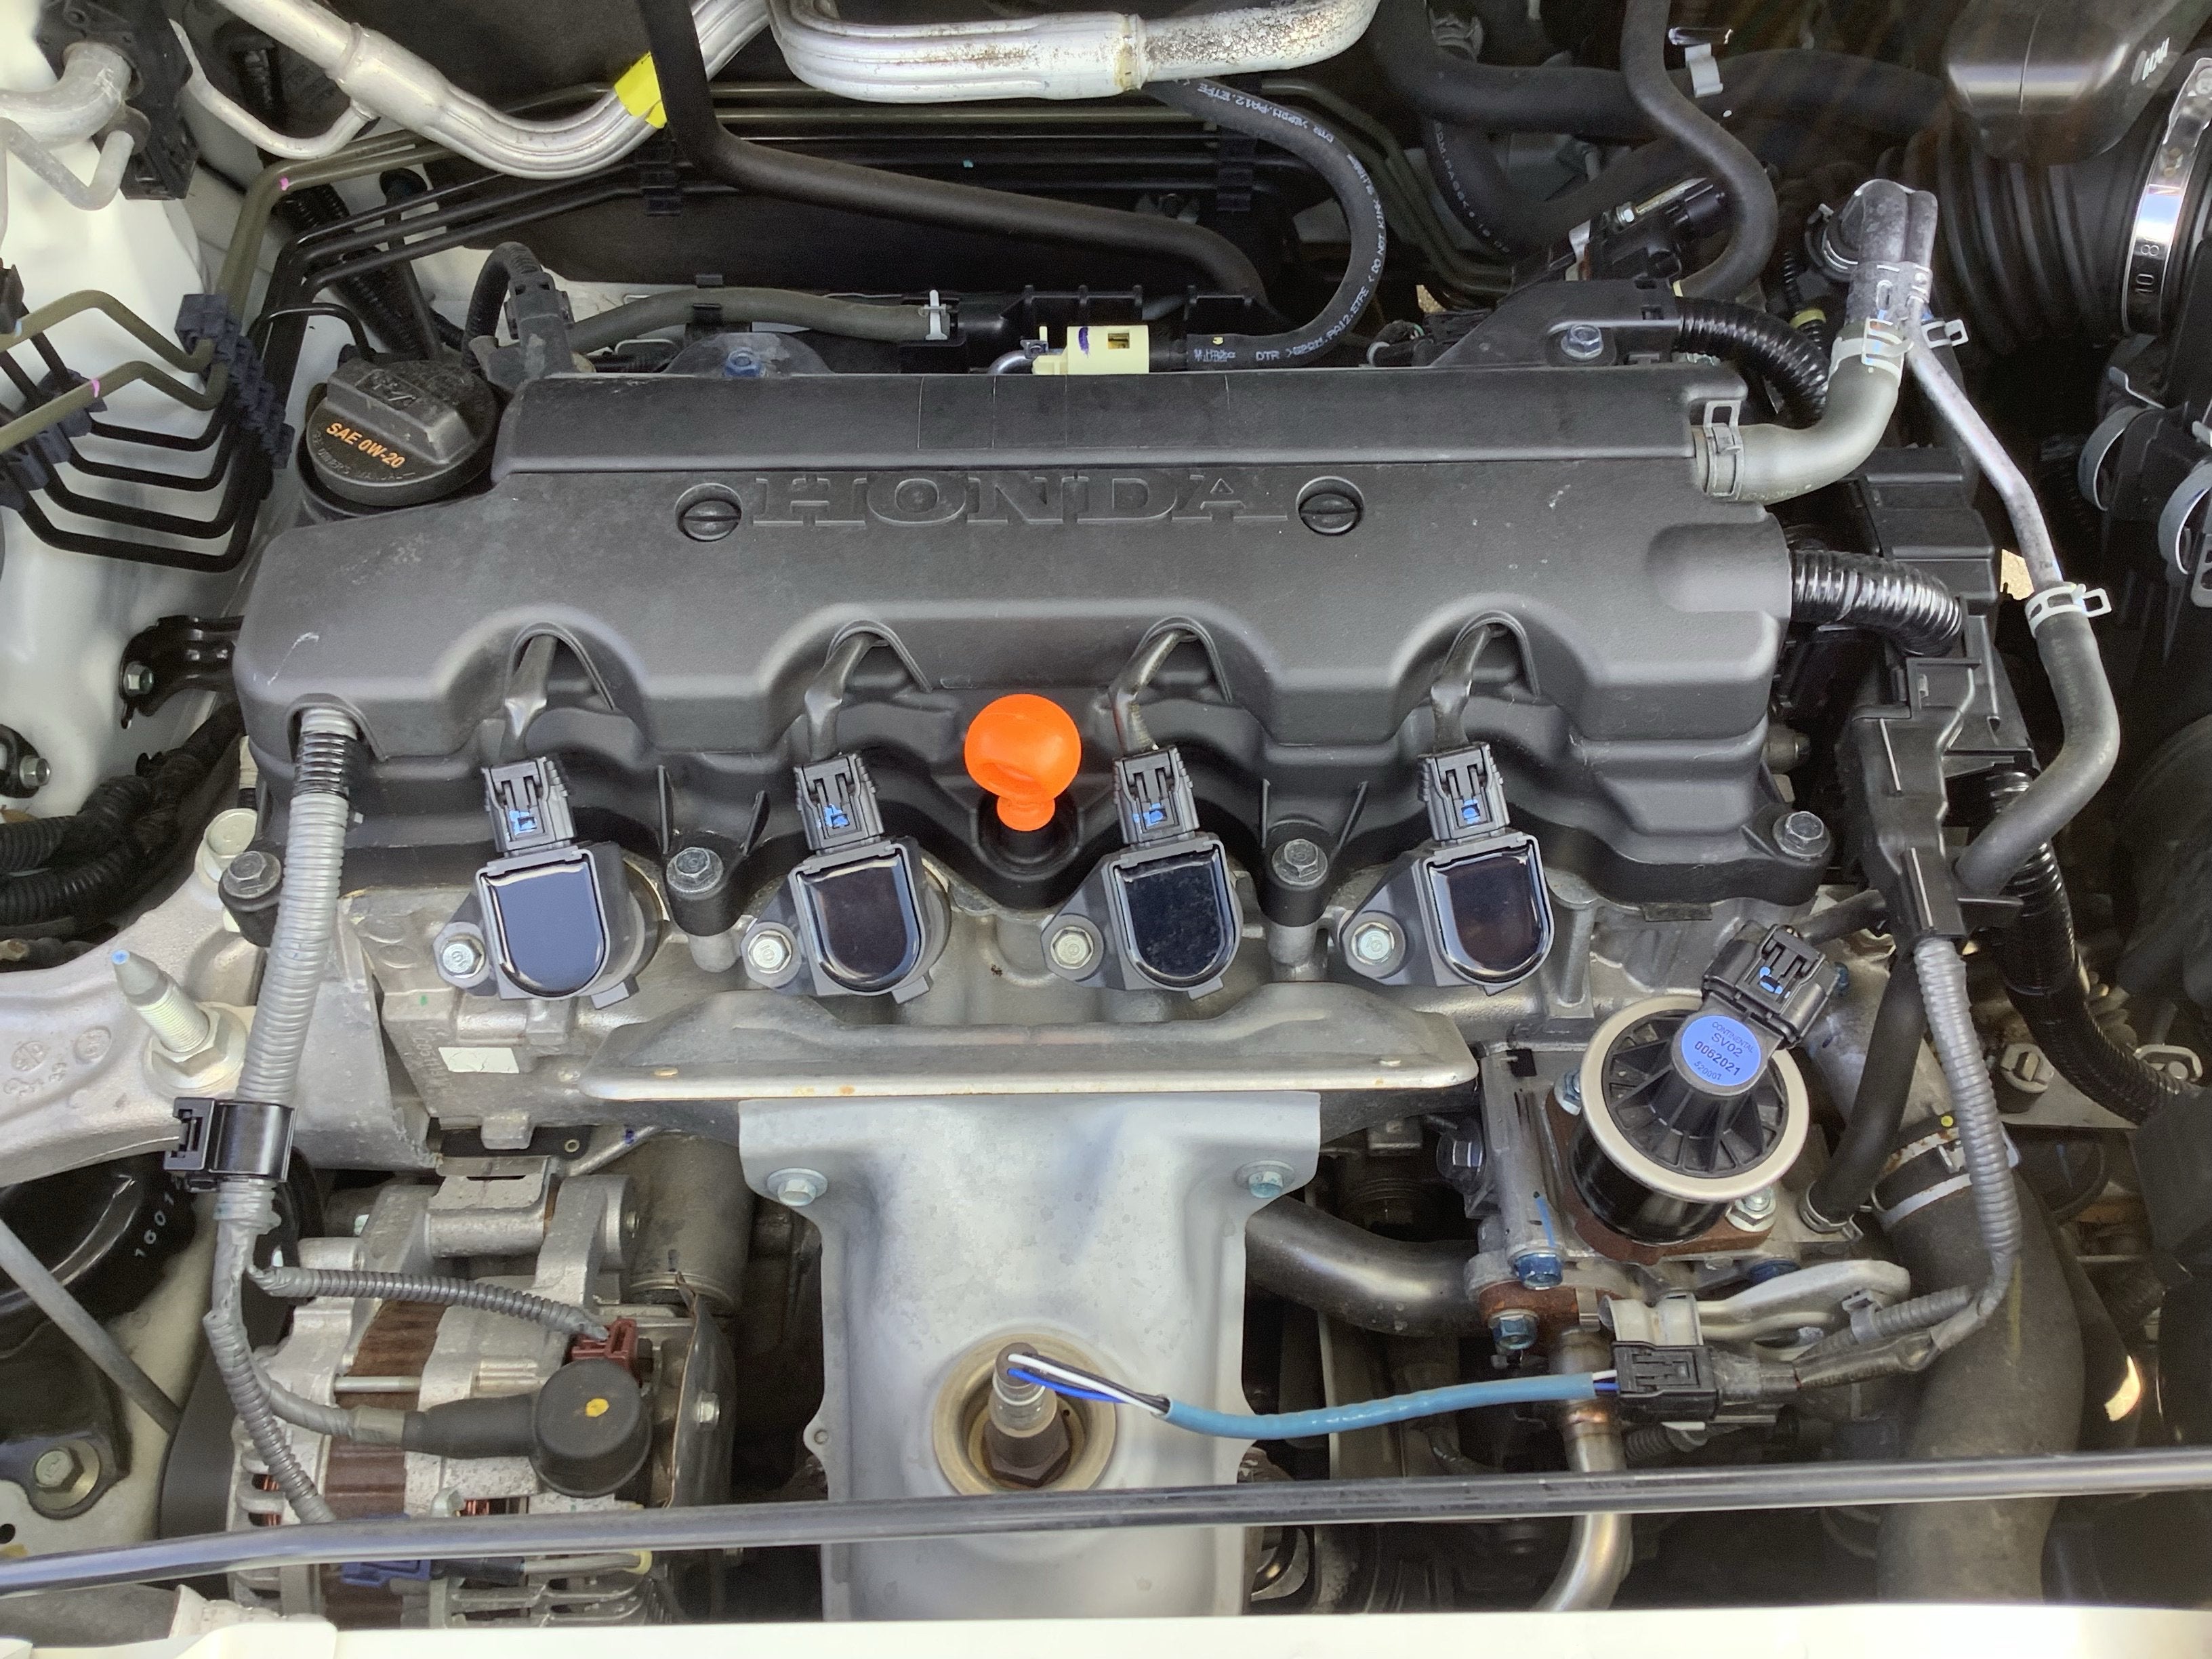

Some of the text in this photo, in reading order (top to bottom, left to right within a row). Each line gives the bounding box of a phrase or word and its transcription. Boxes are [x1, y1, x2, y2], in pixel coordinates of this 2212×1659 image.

[1373, 199, 1385, 230] KINK
[1376, 232, 1385, 255] NOT
[1371, 258, 1382, 274] DO
[2135, 244, 2160, 295] 10 8
[1256, 350, 1280, 361] DTR
[326, 422, 405, 469] SAE 0W-20
[754, 475, 1288, 526] HONDA
[1712, 1021, 1754, 1054] CONTINENTAL
[1694, 1040, 1741, 1076] 0062021
